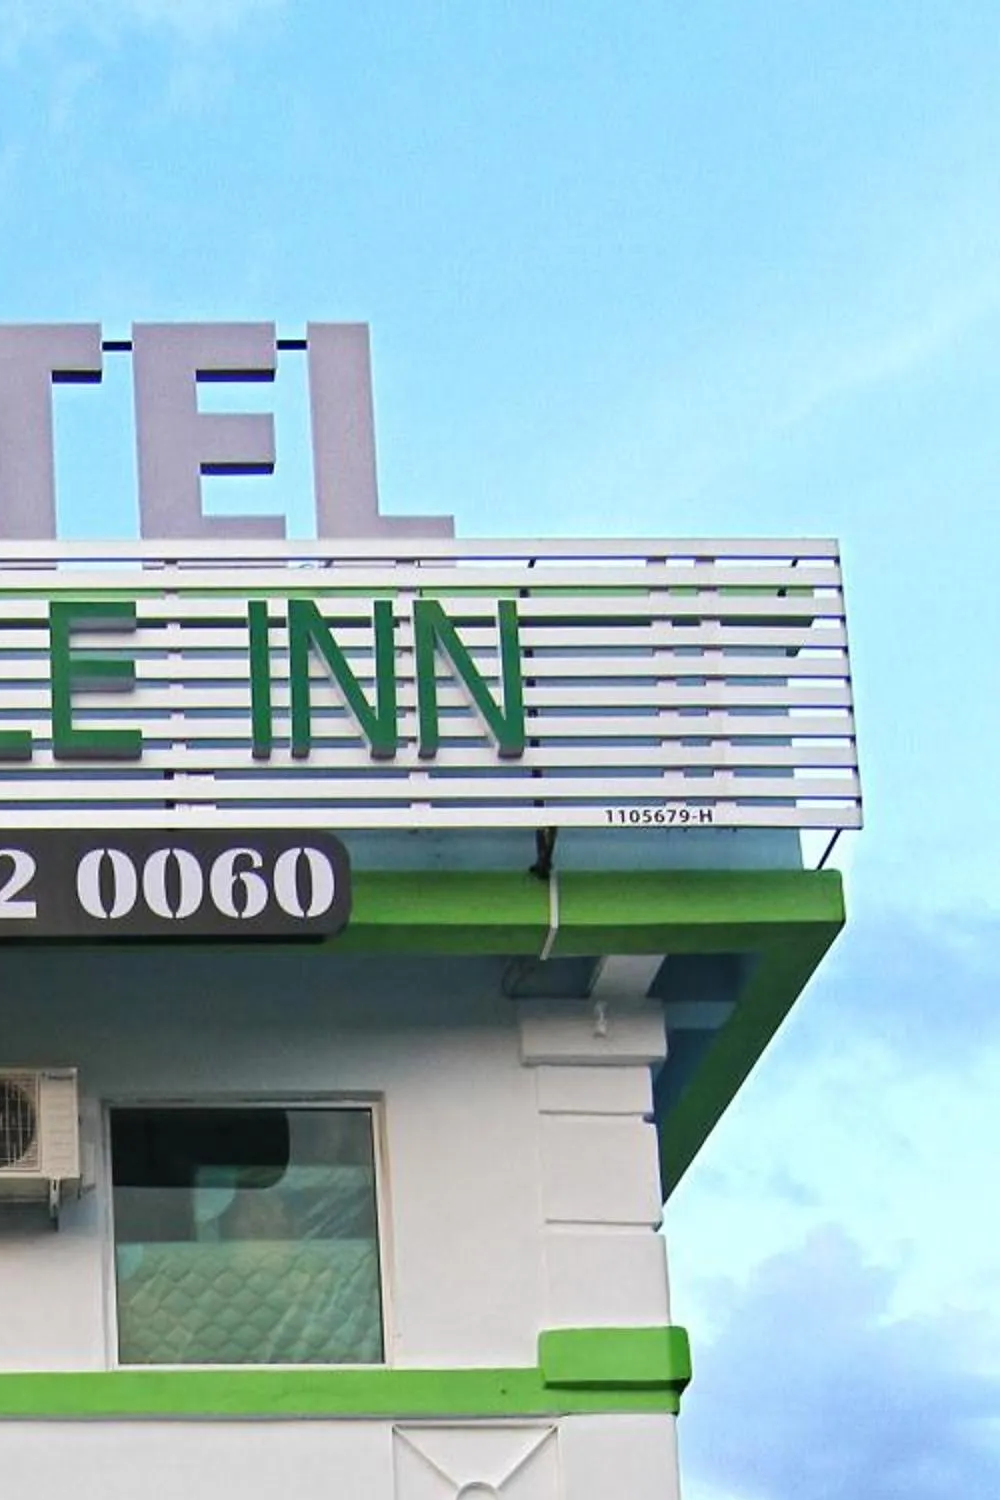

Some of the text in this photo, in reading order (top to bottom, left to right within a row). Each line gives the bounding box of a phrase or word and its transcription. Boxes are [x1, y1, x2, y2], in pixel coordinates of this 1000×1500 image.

[248, 599, 526, 760] INN
[605, 808, 713, 824] 1105679-H
[76, 847, 336, 920] 0060
